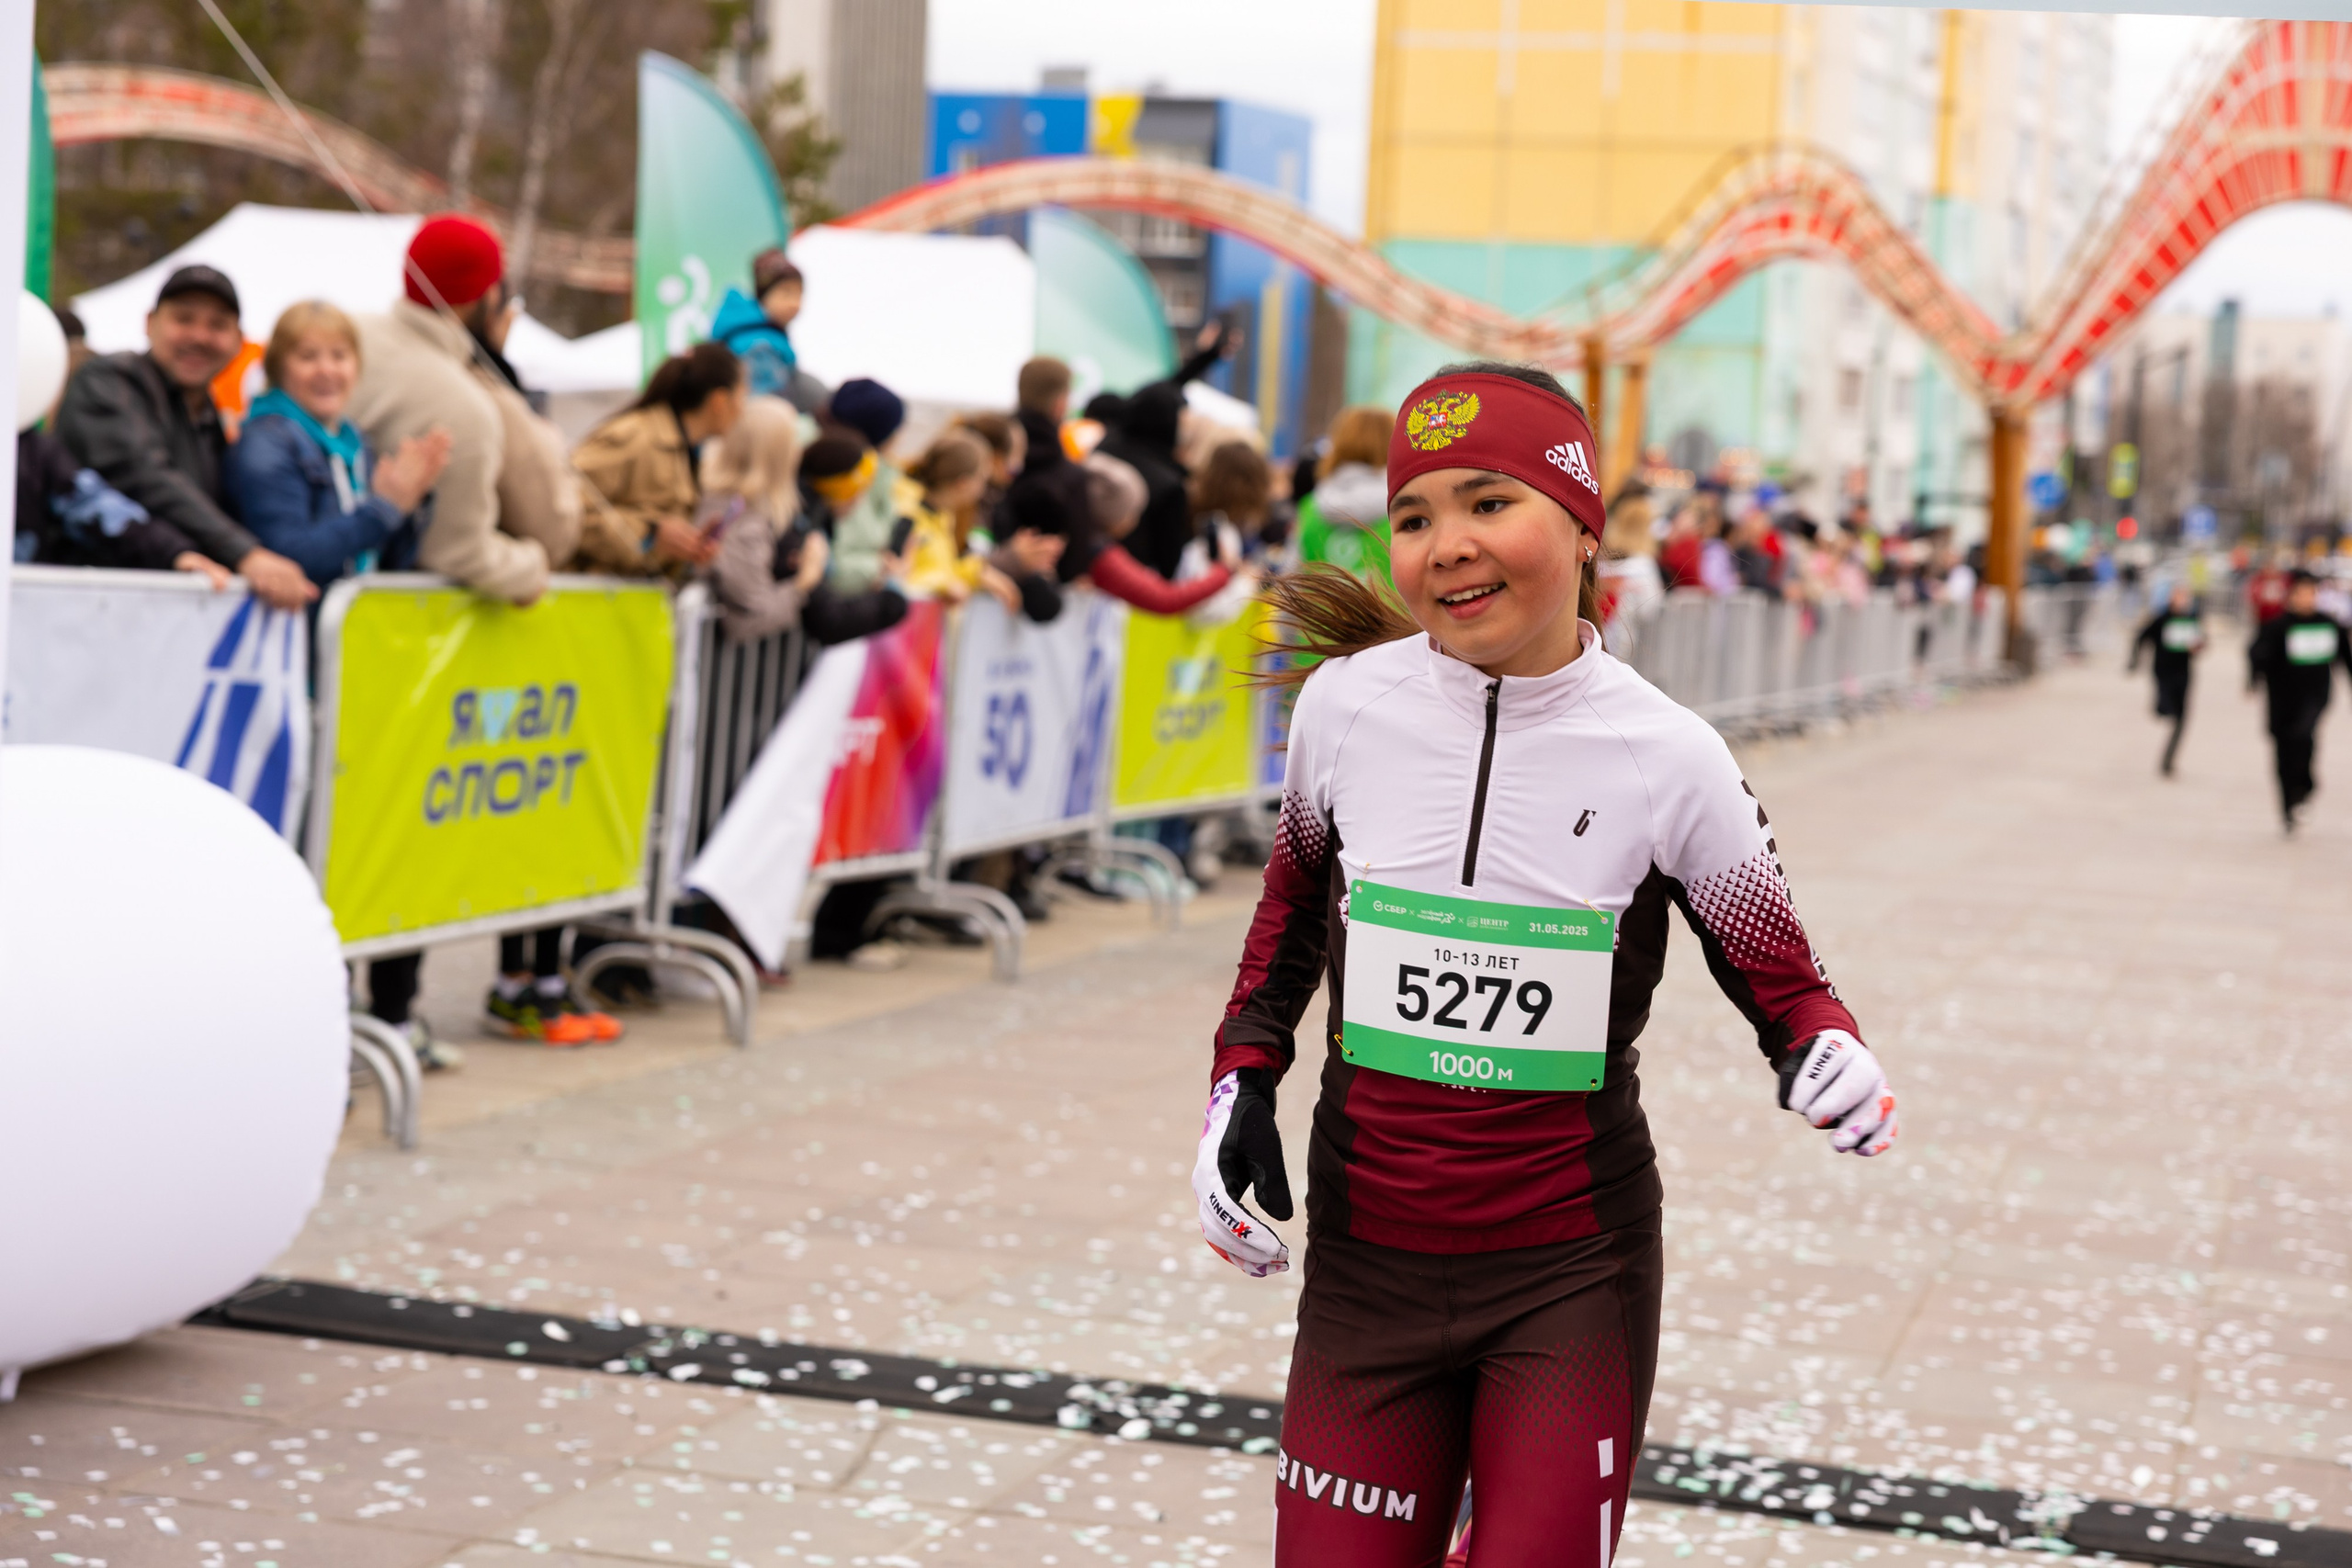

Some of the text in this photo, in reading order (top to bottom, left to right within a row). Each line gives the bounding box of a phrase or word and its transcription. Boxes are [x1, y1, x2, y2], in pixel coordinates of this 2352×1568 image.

[1545, 448, 1599, 495] adidas
[423, 749, 585, 826] СПОРТ
[1384, 904, 1407, 915] СБЕР
[1480, 918, 1509, 927] ЦЕНТР
[1529, 922, 1589, 936] 31.05.2025
[1434, 948, 1520, 970] 10-13 ЛЕТ
[1396, 964, 1553, 1035] 5279
[1430, 1051, 1494, 1079] 1000
